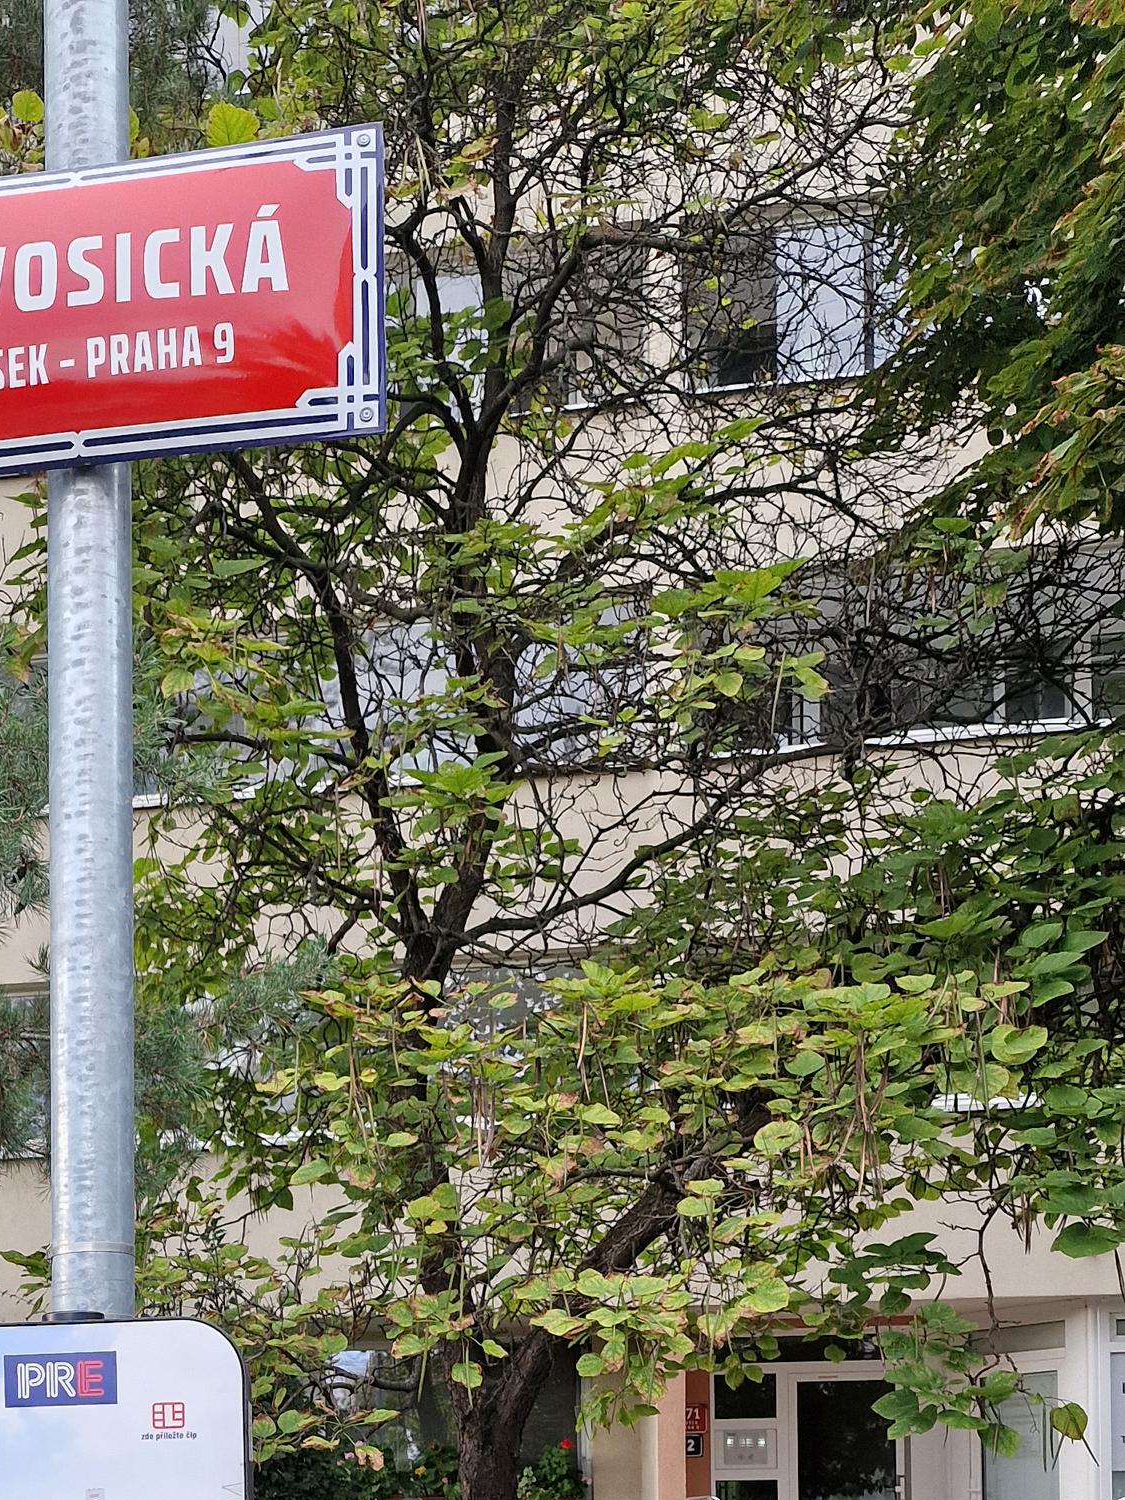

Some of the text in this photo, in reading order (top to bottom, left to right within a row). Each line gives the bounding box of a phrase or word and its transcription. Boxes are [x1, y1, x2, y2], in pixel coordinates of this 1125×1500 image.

[86, 330, 203, 379] PRAHA
[213, 321, 236, 365] 9
[17, 1360, 104, 1399] PRE
